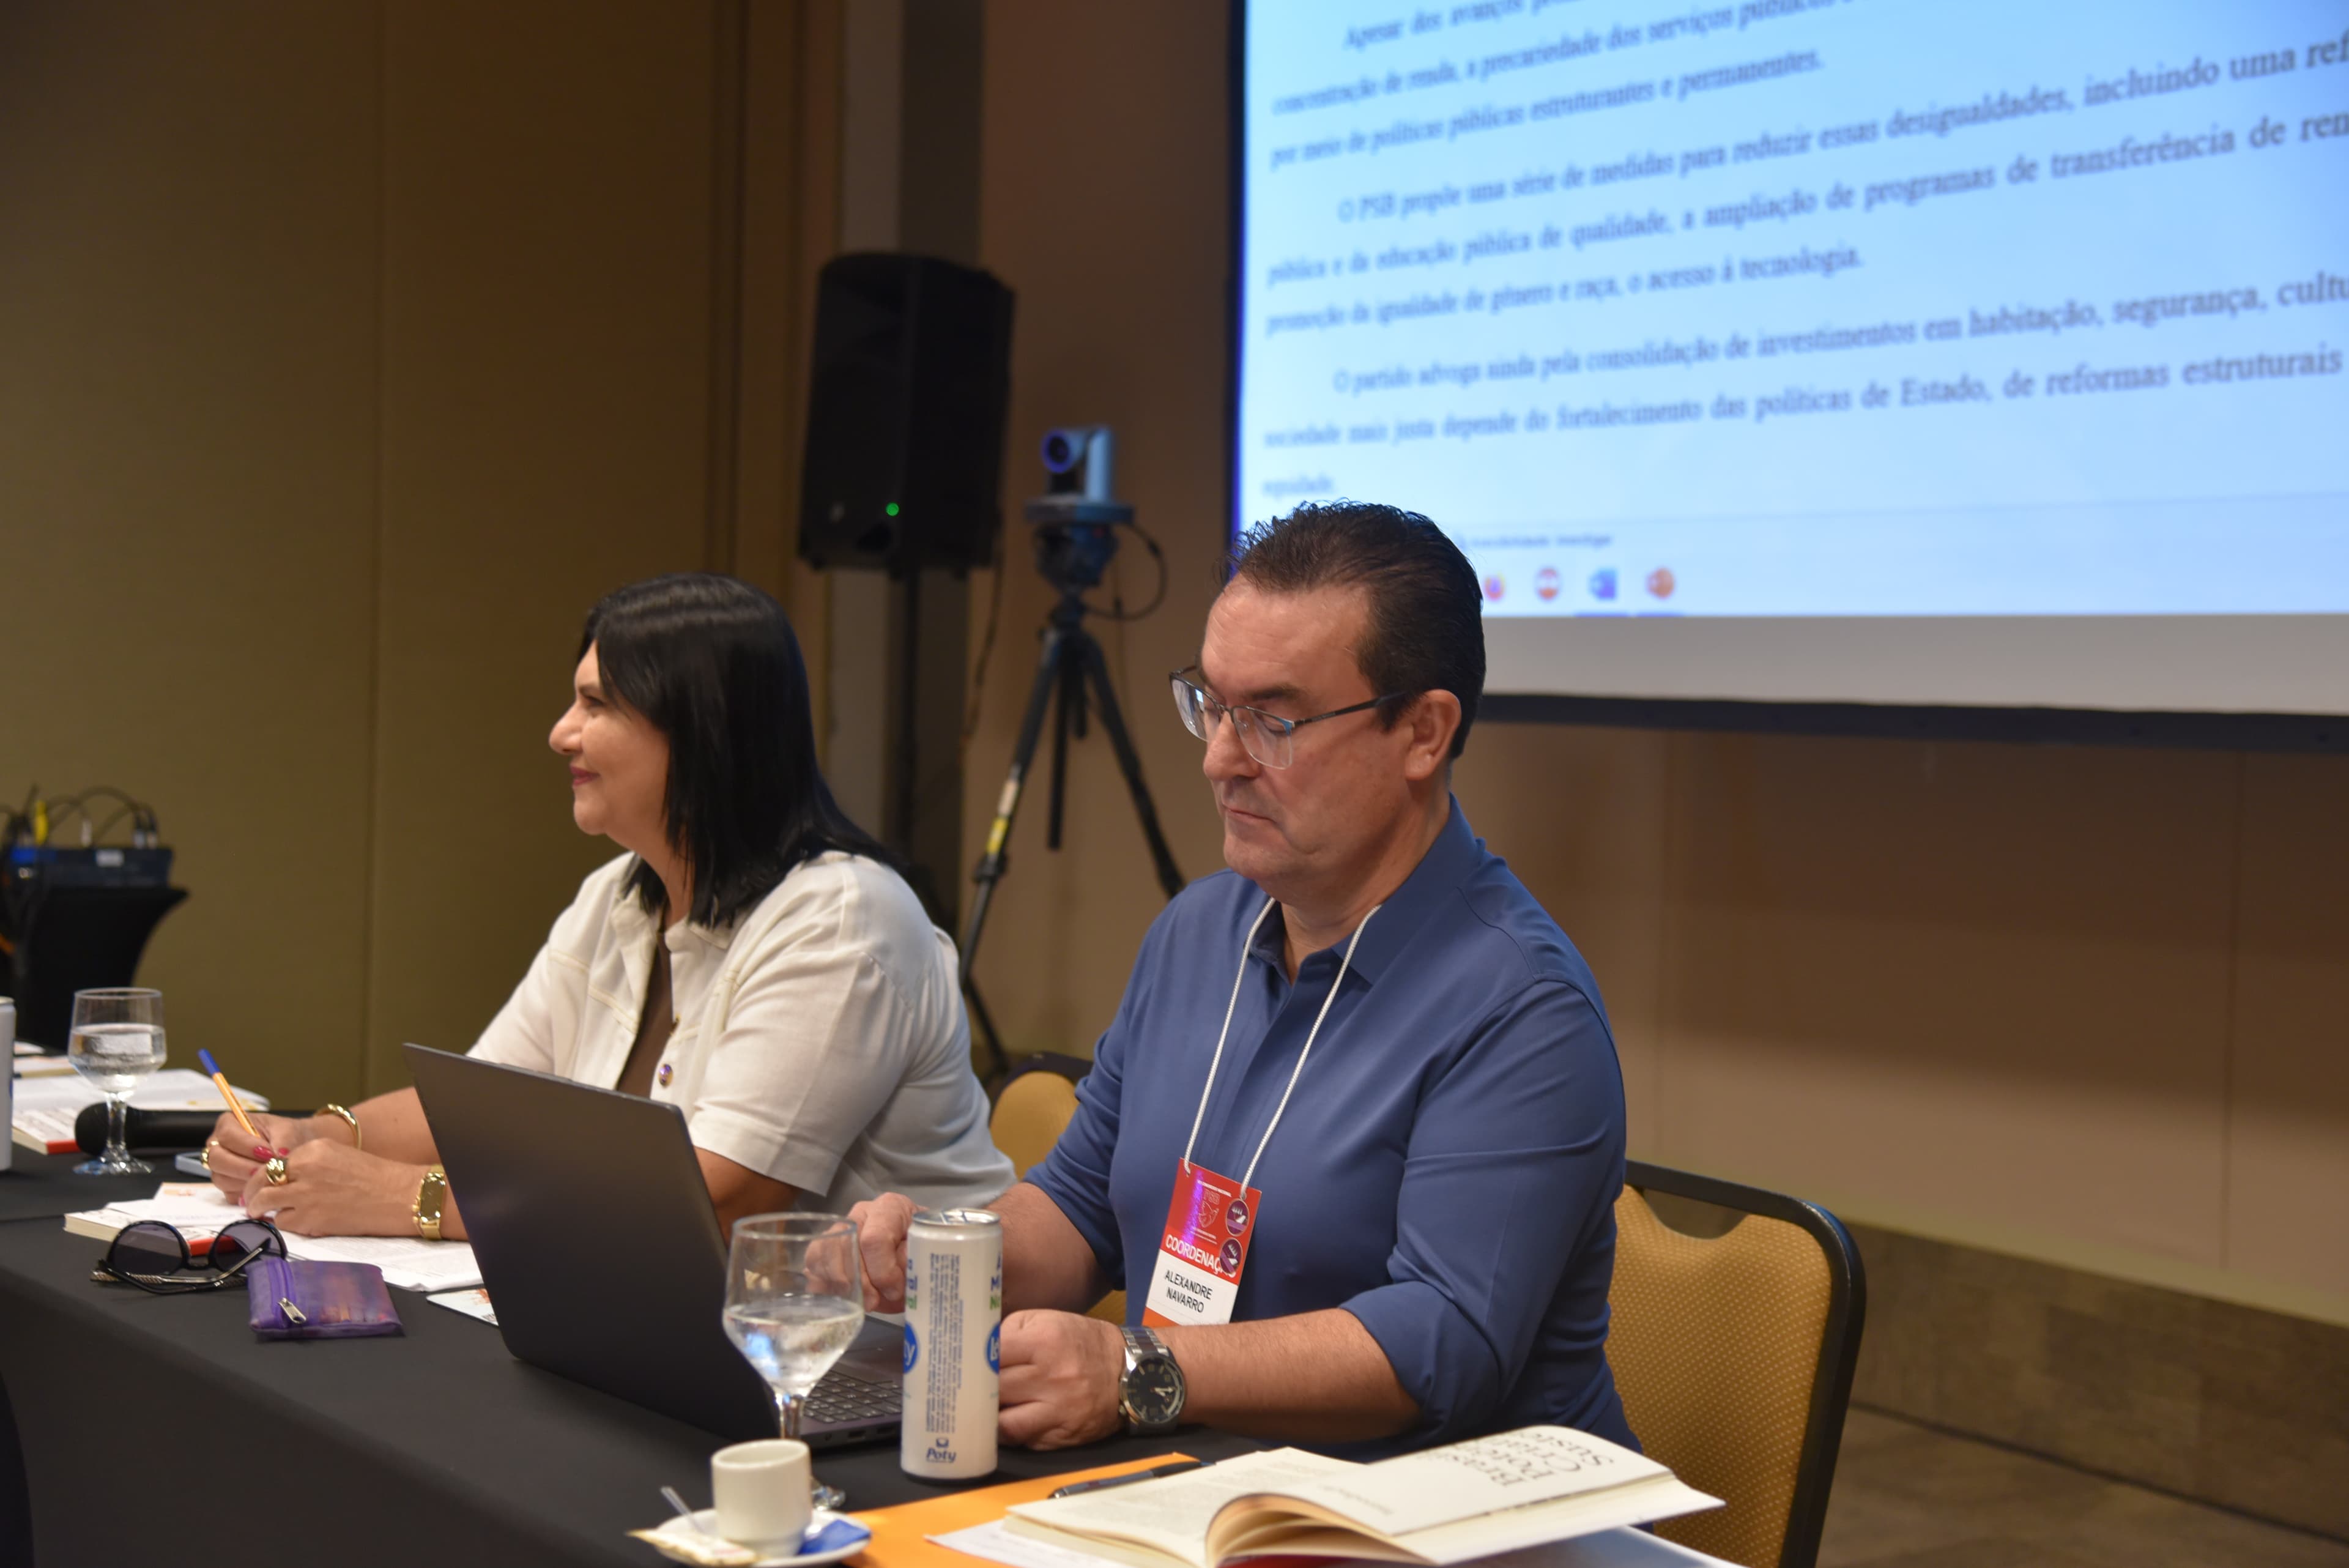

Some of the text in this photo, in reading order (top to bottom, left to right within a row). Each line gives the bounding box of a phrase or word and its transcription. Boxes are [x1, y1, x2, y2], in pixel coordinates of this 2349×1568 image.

[1661, 80, 1673, 96] e
[1678, 50, 1825, 102] permanentes.
[1680, 147, 1726, 176] para
[1733, 125, 1811, 162] reduzir
[1819, 124, 1877, 149] essas
[1887, 87, 2073, 137] desigualdades,
[2085, 58, 2219, 105] incluindo
[2230, 51, 2293, 78] uma
[1683, 212, 1694, 229] a
[1704, 190, 1817, 229] ampliação
[1827, 184, 1854, 209] de
[1865, 169, 1994, 210] programas
[2008, 157, 2038, 184] de
[2052, 133, 2234, 176] transferência
[2250, 119, 2284, 148] de
[1740, 243, 1864, 279] tecnologia.
[1724, 335, 1750, 359] de
[1758, 324, 1916, 355] investimentos
[1924, 320, 1961, 340] em
[1970, 302, 2102, 336] habitação,
[2115, 290, 2268, 326] segurança,
[1711, 395, 1746, 418] das
[1756, 390, 1850, 422] políticas
[1861, 384, 1888, 408] de
[1901, 376, 1992, 406] Estado,
[2004, 372, 2033, 398] de
[2047, 365, 2168, 395] reformas
[2183, 343, 2341, 384] estruturais
[1166, 1235, 1236, 1277] COORDENAÇ
[1165, 1269, 1212, 1299] ALEXANDRE
[1167, 1287, 1204, 1313] NAVARRO
[926, 1447, 957, 1463] Poty
